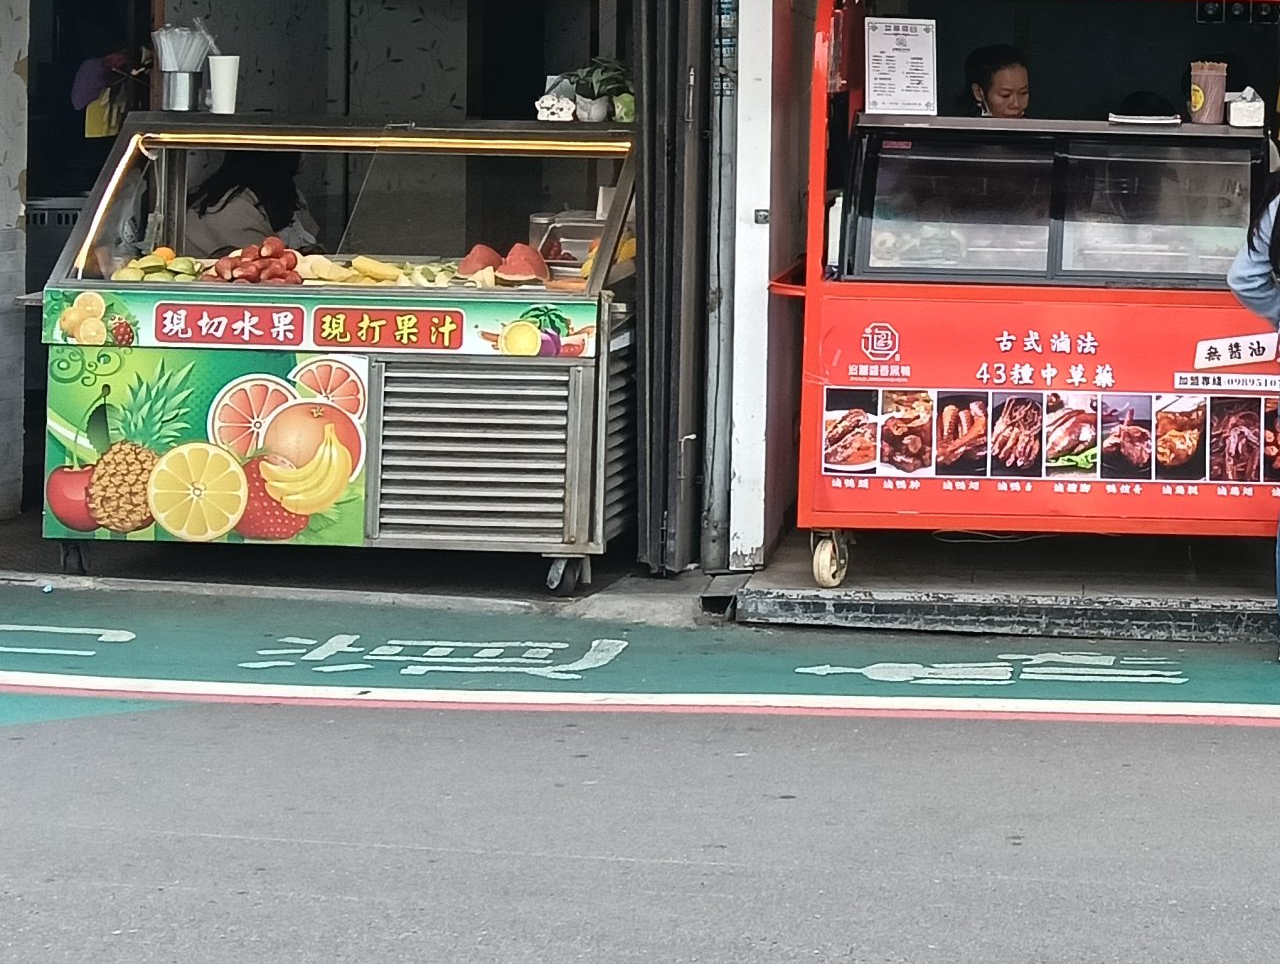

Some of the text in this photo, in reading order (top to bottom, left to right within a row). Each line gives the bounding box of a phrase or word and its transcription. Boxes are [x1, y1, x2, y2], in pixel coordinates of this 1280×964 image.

[161, 309, 297, 340] 現切水果
[320, 312, 459, 346] 現打果汁
[1204, 340, 1266, 362] 無醬油
